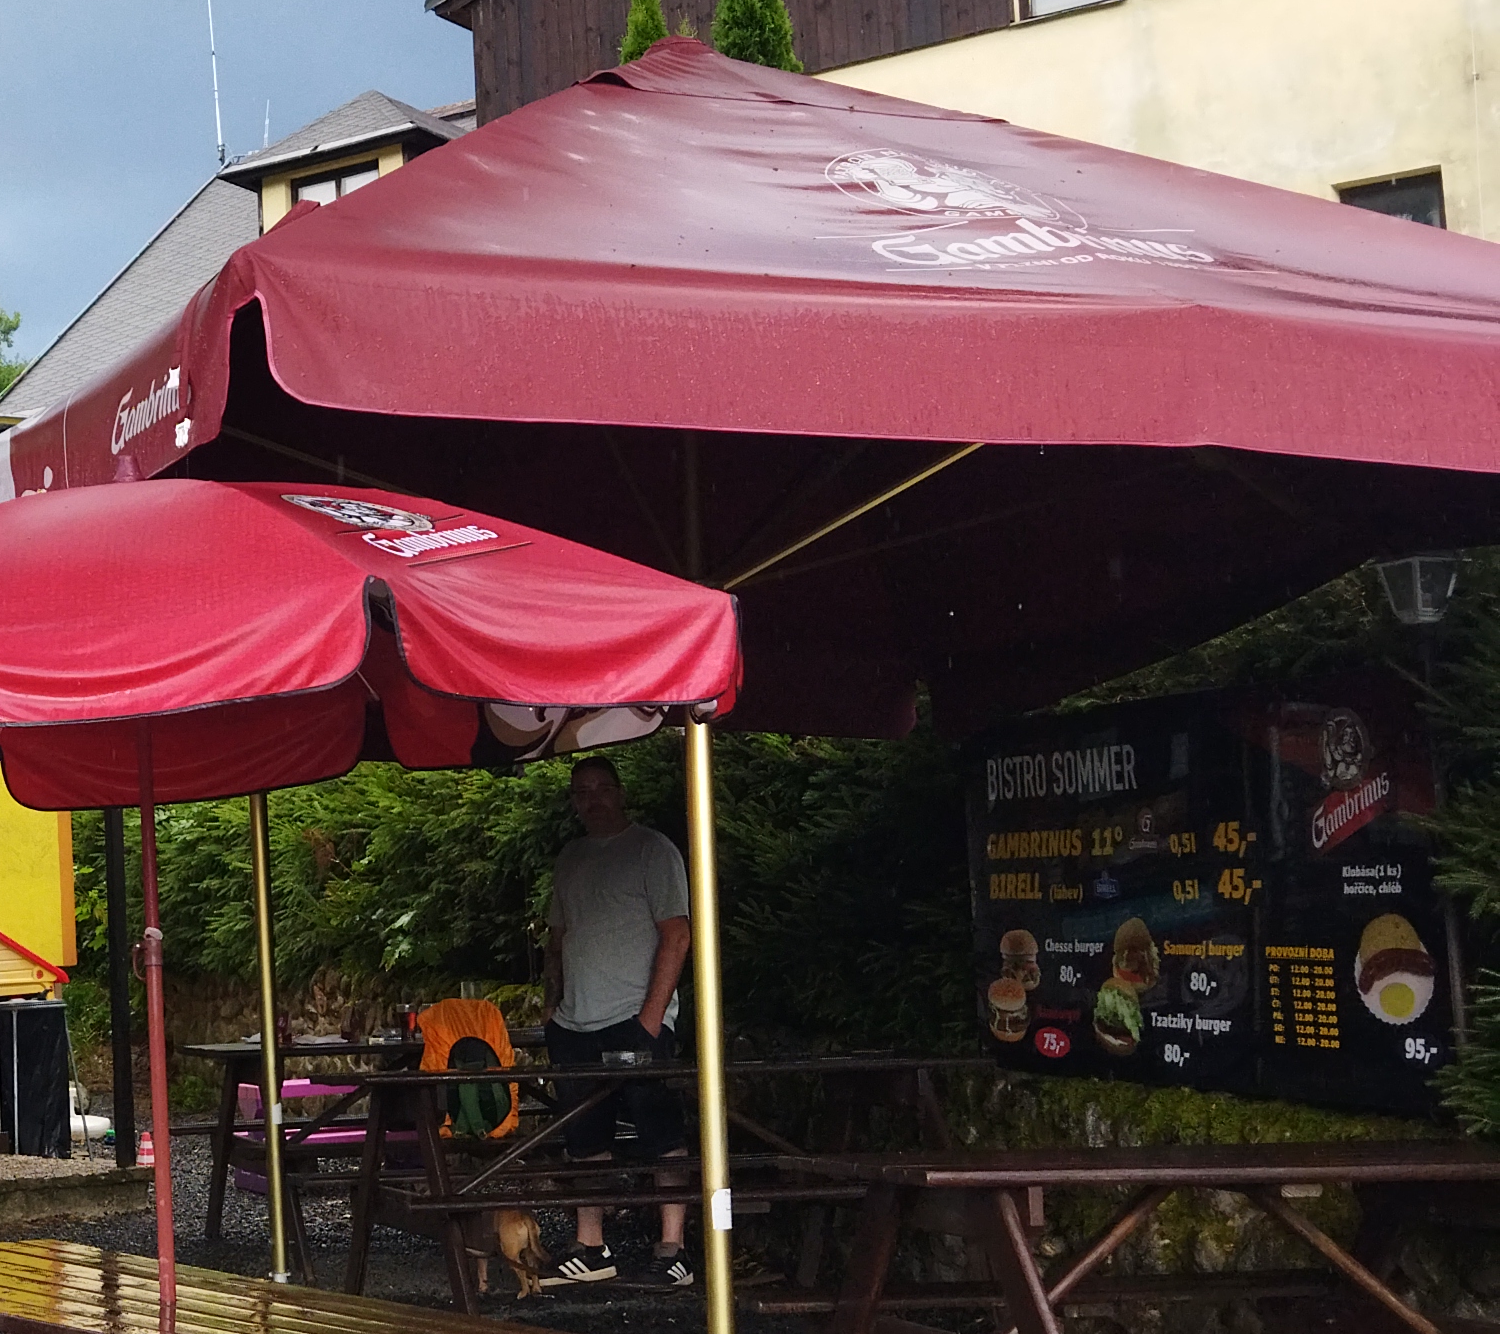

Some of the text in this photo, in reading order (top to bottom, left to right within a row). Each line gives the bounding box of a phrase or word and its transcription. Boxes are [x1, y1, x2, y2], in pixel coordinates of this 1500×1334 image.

[986, 744, 1137, 800] BISTRO SOMMER
[1312, 772, 1389, 849] Gambrinus
[987, 828, 1082, 860] GAMBRINUS
[1213, 821, 1257, 858] 45,-
[989, 873, 1043, 900] BIRELL
[1217, 868, 1262, 905] 45,-
[1074, 940, 1104, 956] burger
[1164, 940, 1244, 960] Samuraj burger
[1060, 966, 1081, 986] 80,-
[1190, 972, 1217, 995] 80,-
[1151, 1012, 1231, 1035] Tzatziky burger
[1043, 1033, 1064, 1054] 75,-
[1164, 1043, 1190, 1067] 80,-
[1404, 1037, 1437, 1064] 95,-
